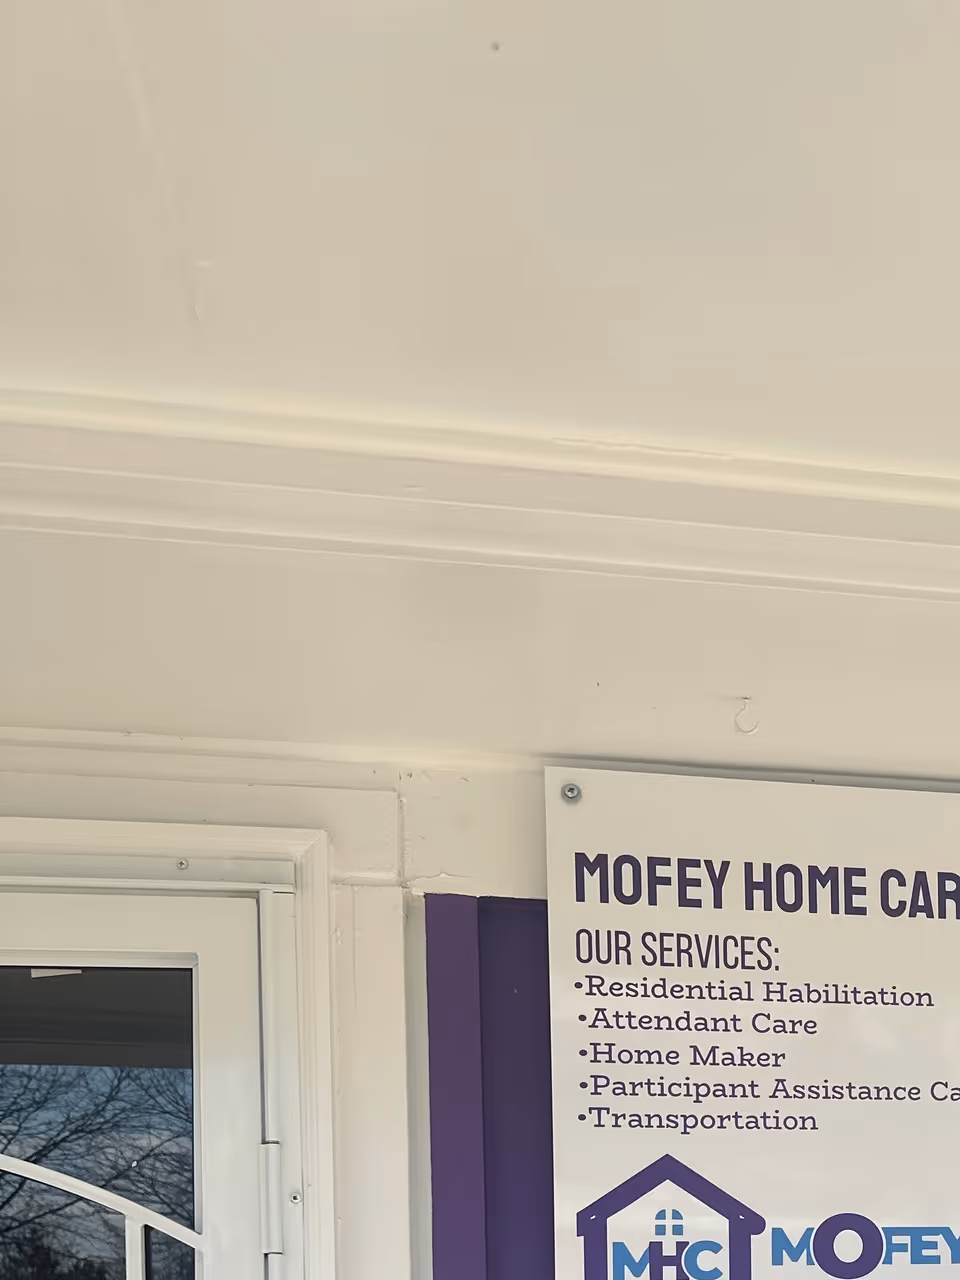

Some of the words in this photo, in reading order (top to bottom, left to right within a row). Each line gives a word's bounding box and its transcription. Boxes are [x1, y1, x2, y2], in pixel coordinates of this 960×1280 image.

[574, 851, 731, 910] MOFEY
[743, 860, 868, 916] HOME
[575, 928, 633, 966] OUR
[640, 931, 781, 972] SERVICES:
[584, 974, 755, 1003] Residential
[762, 980, 935, 1008] Habilitation
[588, 1007, 743, 1033] Attendant
[751, 1012, 818, 1035] Care
[589, 1042, 681, 1066] Home
[689, 1044, 786, 1068] Maker
[589, 1074, 761, 1103] Participant
[768, 1078, 922, 1102] Assistance
[588, 1106, 819, 1135] Transportation
